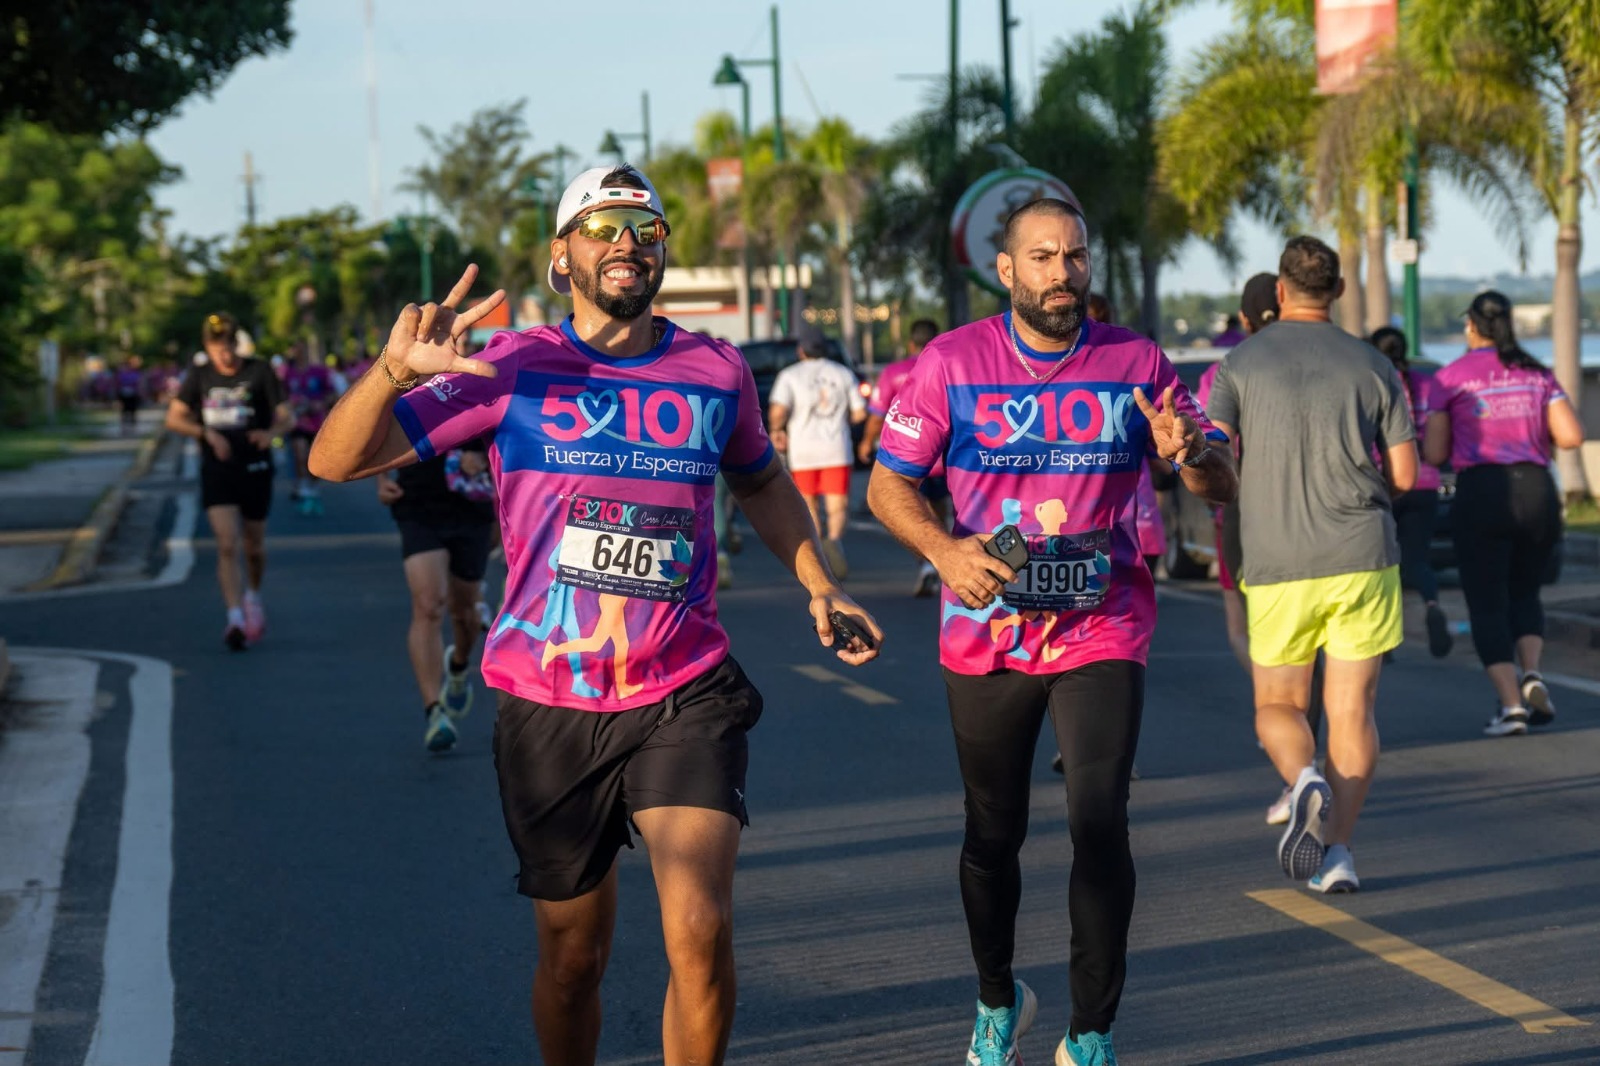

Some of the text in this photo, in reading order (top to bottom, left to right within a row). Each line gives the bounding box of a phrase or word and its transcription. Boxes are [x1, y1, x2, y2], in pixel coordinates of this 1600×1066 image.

[544, 446, 718, 477] Fuerza y Esperanza
[978, 450, 1130, 471] Fuerza y Esperanza
[575, 518, 595, 526] Fuerza
[600, 521, 630, 532] Esperanza
[591, 533, 655, 578] 646
[1024, 561, 1087, 594] 1990
